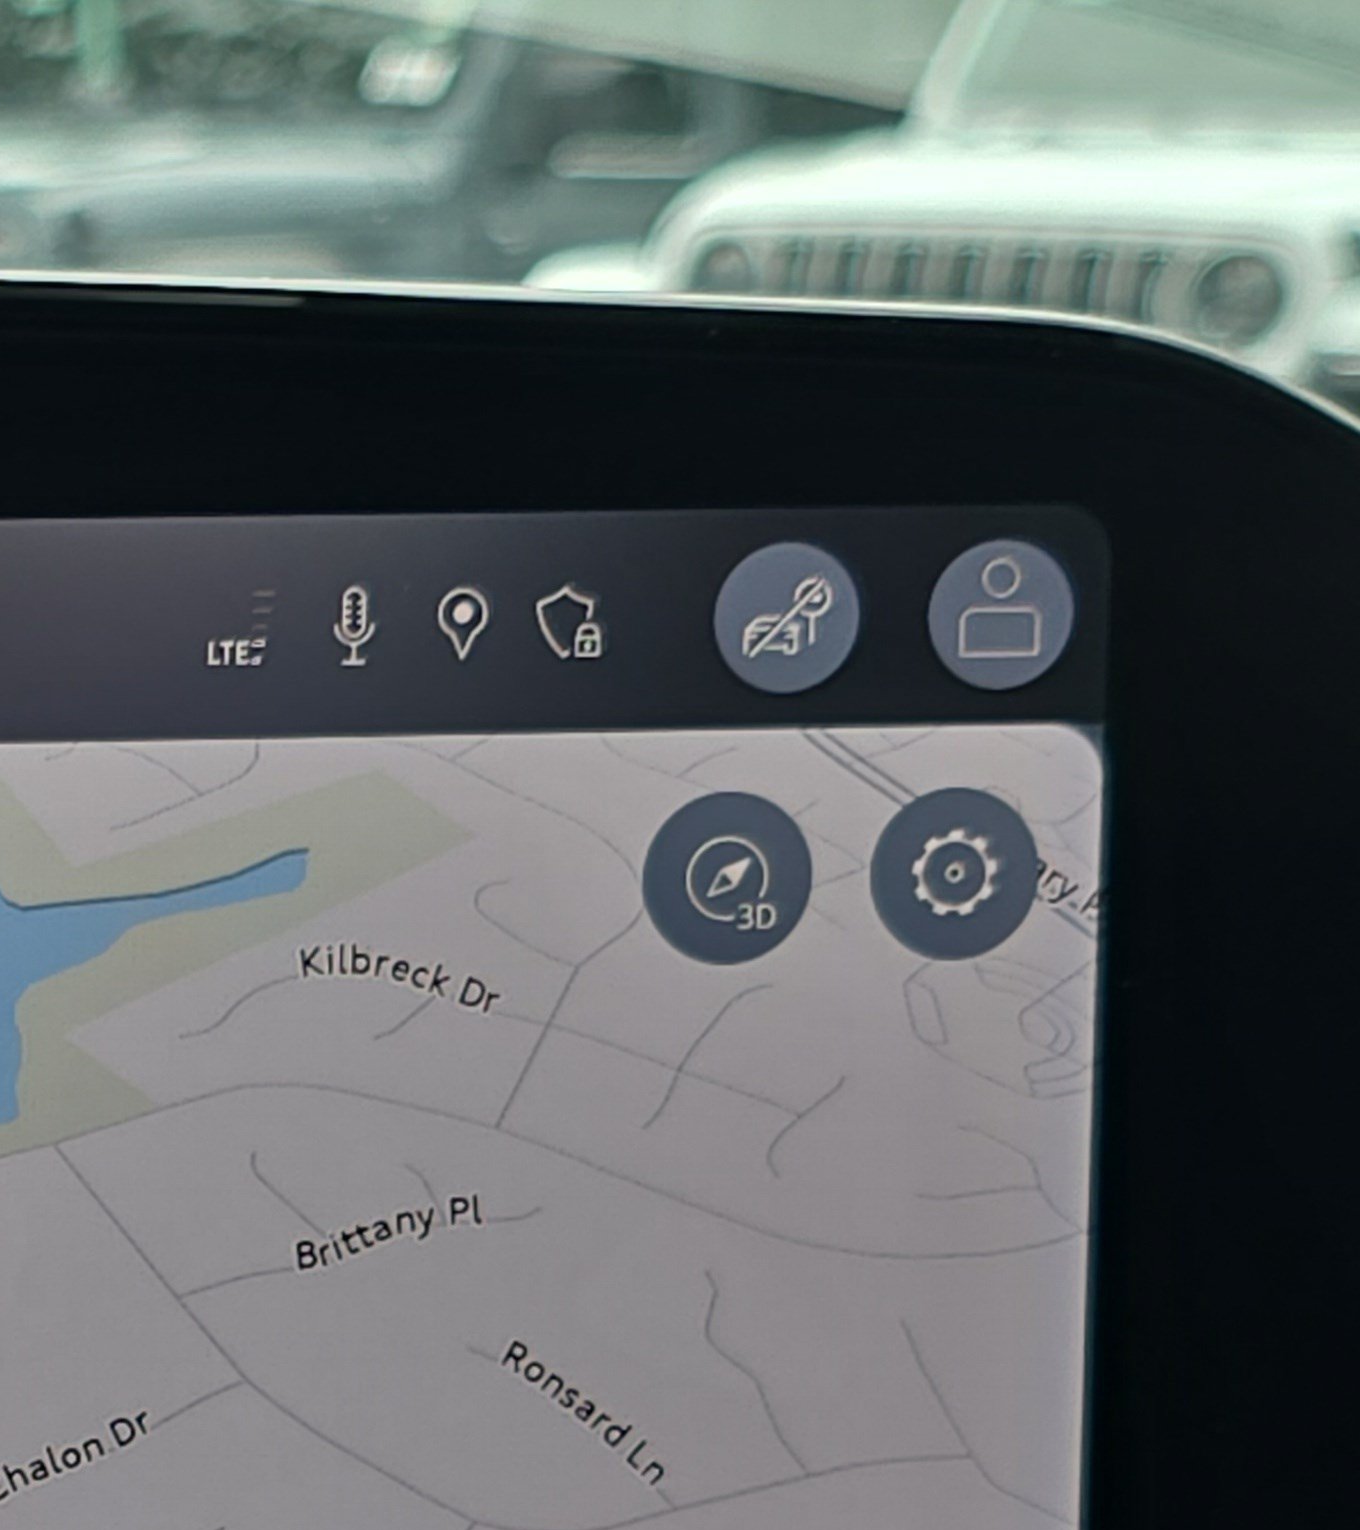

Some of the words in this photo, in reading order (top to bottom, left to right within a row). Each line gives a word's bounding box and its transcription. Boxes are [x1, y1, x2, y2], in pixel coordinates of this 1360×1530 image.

[207, 638, 251, 666] LTE
[736, 903, 777, 930] 3D
[300, 943, 451, 998] Kilbreck
[458, 976, 500, 1014] Dr
[295, 1206, 434, 1272] Brittany
[449, 1195, 483, 1226] Pl
[110, 1408, 150, 1447] Dr
[501, 1340, 631, 1443] Ronsard
[626, 1440, 666, 1485] Ln
